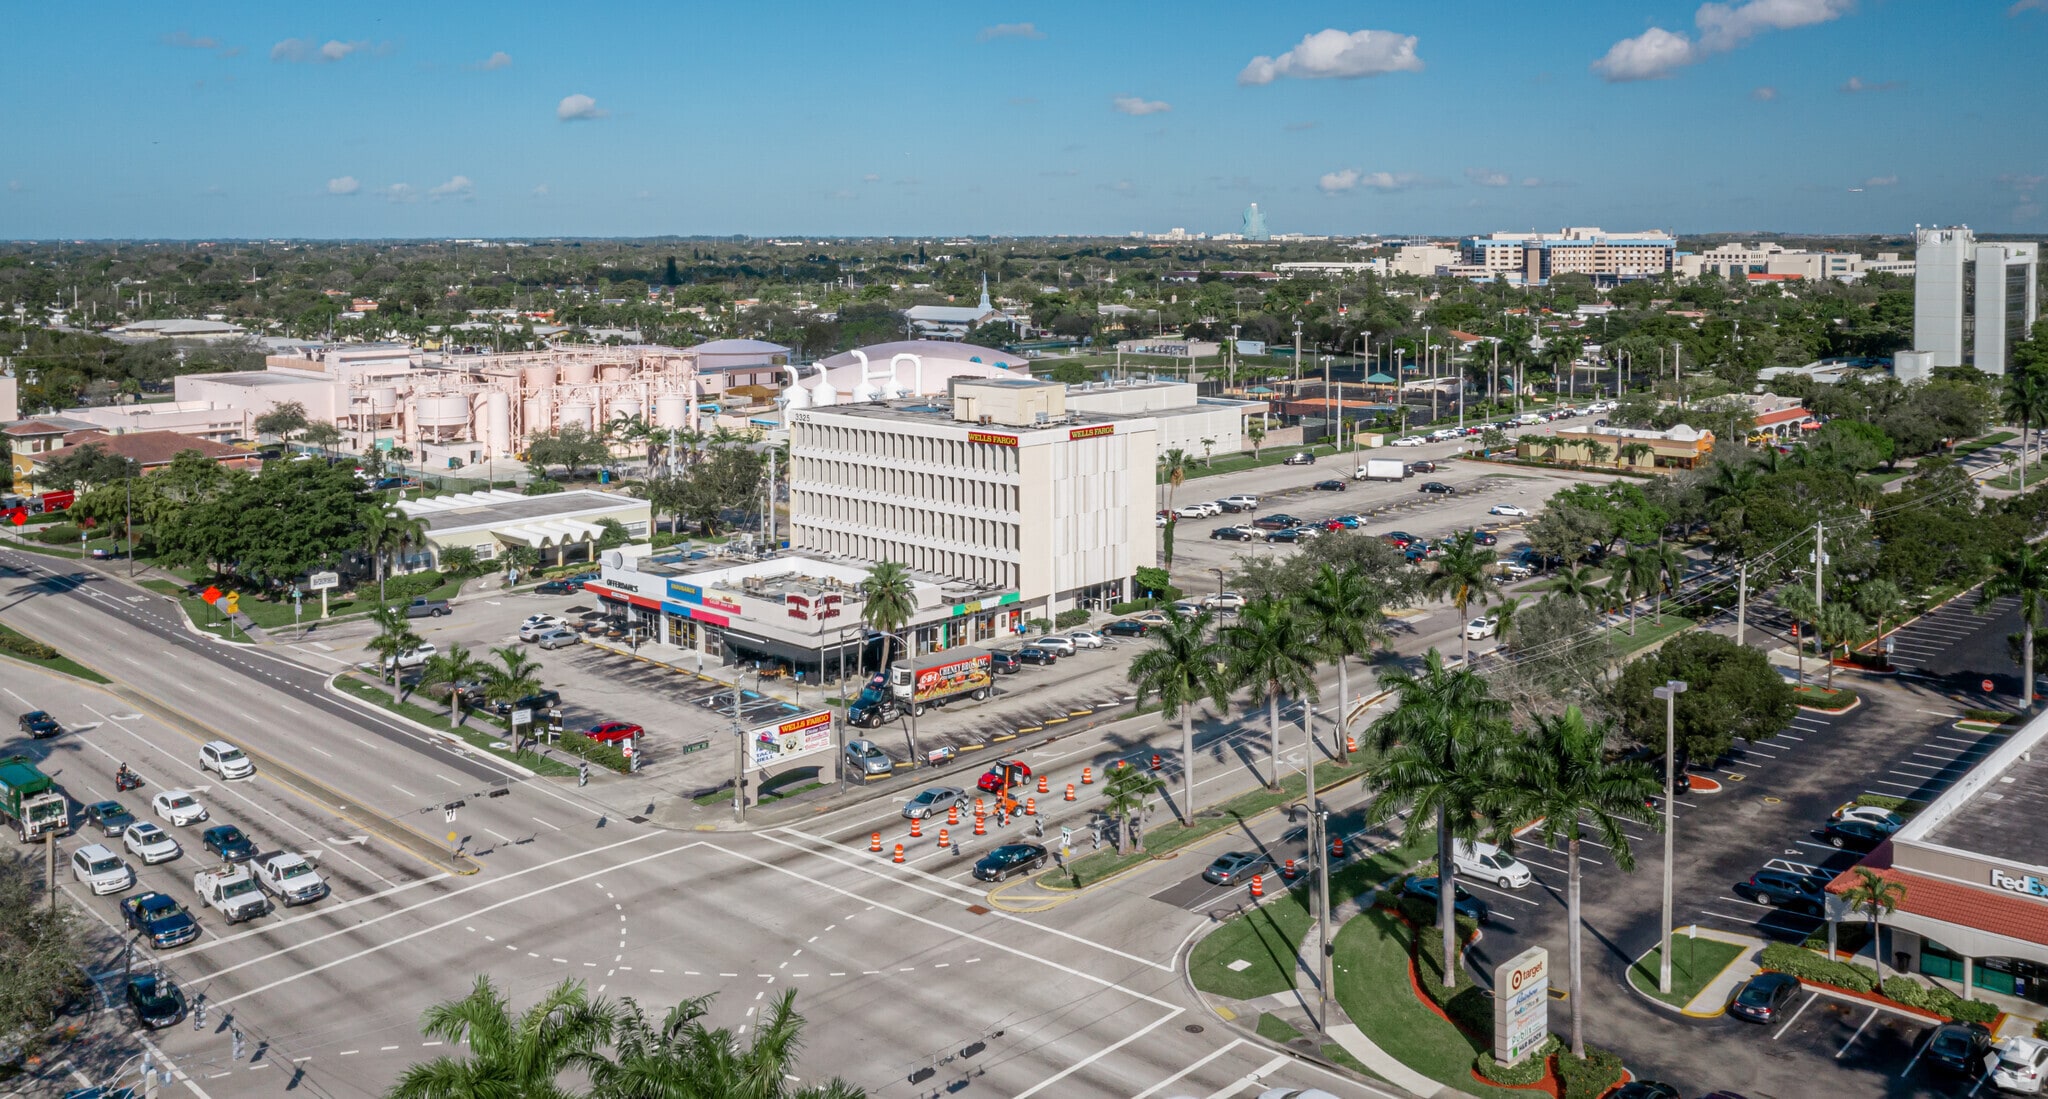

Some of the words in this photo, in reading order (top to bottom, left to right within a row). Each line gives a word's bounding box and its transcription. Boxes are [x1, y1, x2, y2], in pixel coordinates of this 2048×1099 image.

[795, 412, 810, 422] 3325
[1071, 430, 1094, 439] WELLS
[1094, 426, 1114, 436] FARGO
[968, 433, 992, 443] WELLS
[993, 435, 1016, 446] FARGO
[781, 720, 806, 733] WELLS
[806, 714, 829, 728] FARGO
[1523, 961, 1543, 981] target
